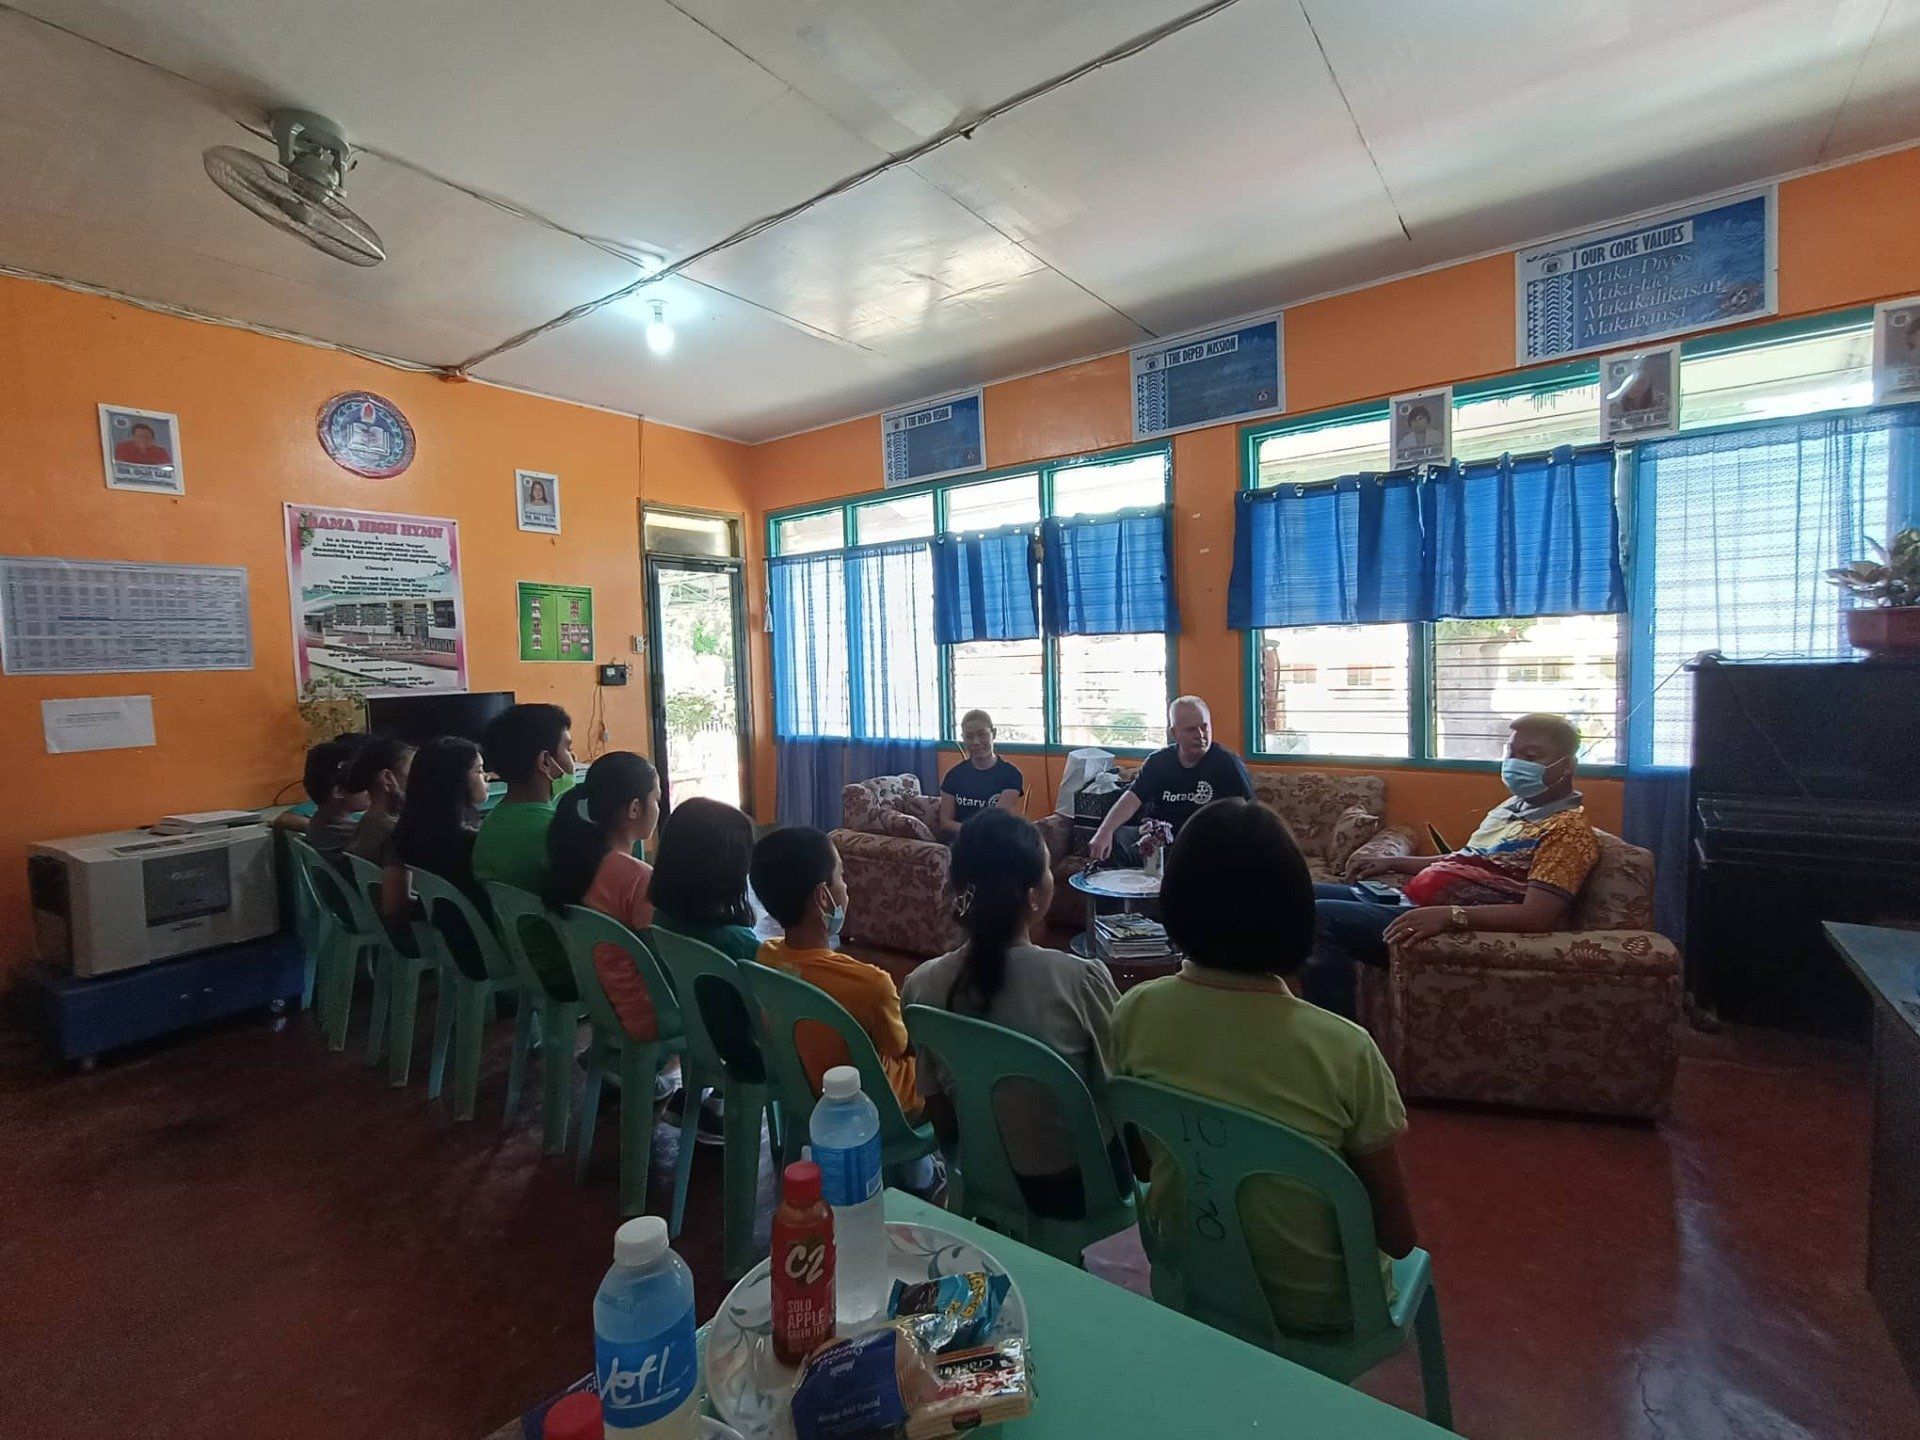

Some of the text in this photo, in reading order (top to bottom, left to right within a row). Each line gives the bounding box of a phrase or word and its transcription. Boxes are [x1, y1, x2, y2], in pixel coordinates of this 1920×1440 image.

[1581, 225, 1685, 267] OUR CORE VALUES
[1584, 306, 1687, 339] Makabansa
[1168, 336, 1236, 366] THE DEPED MISSION
[358, 520, 397, 535] HIGH
[401, 524, 444, 539] HYMN
[785, 1245, 826, 1284] C2
[787, 1307, 825, 1329] APPLE
[788, 1299, 812, 1313] SOLO
